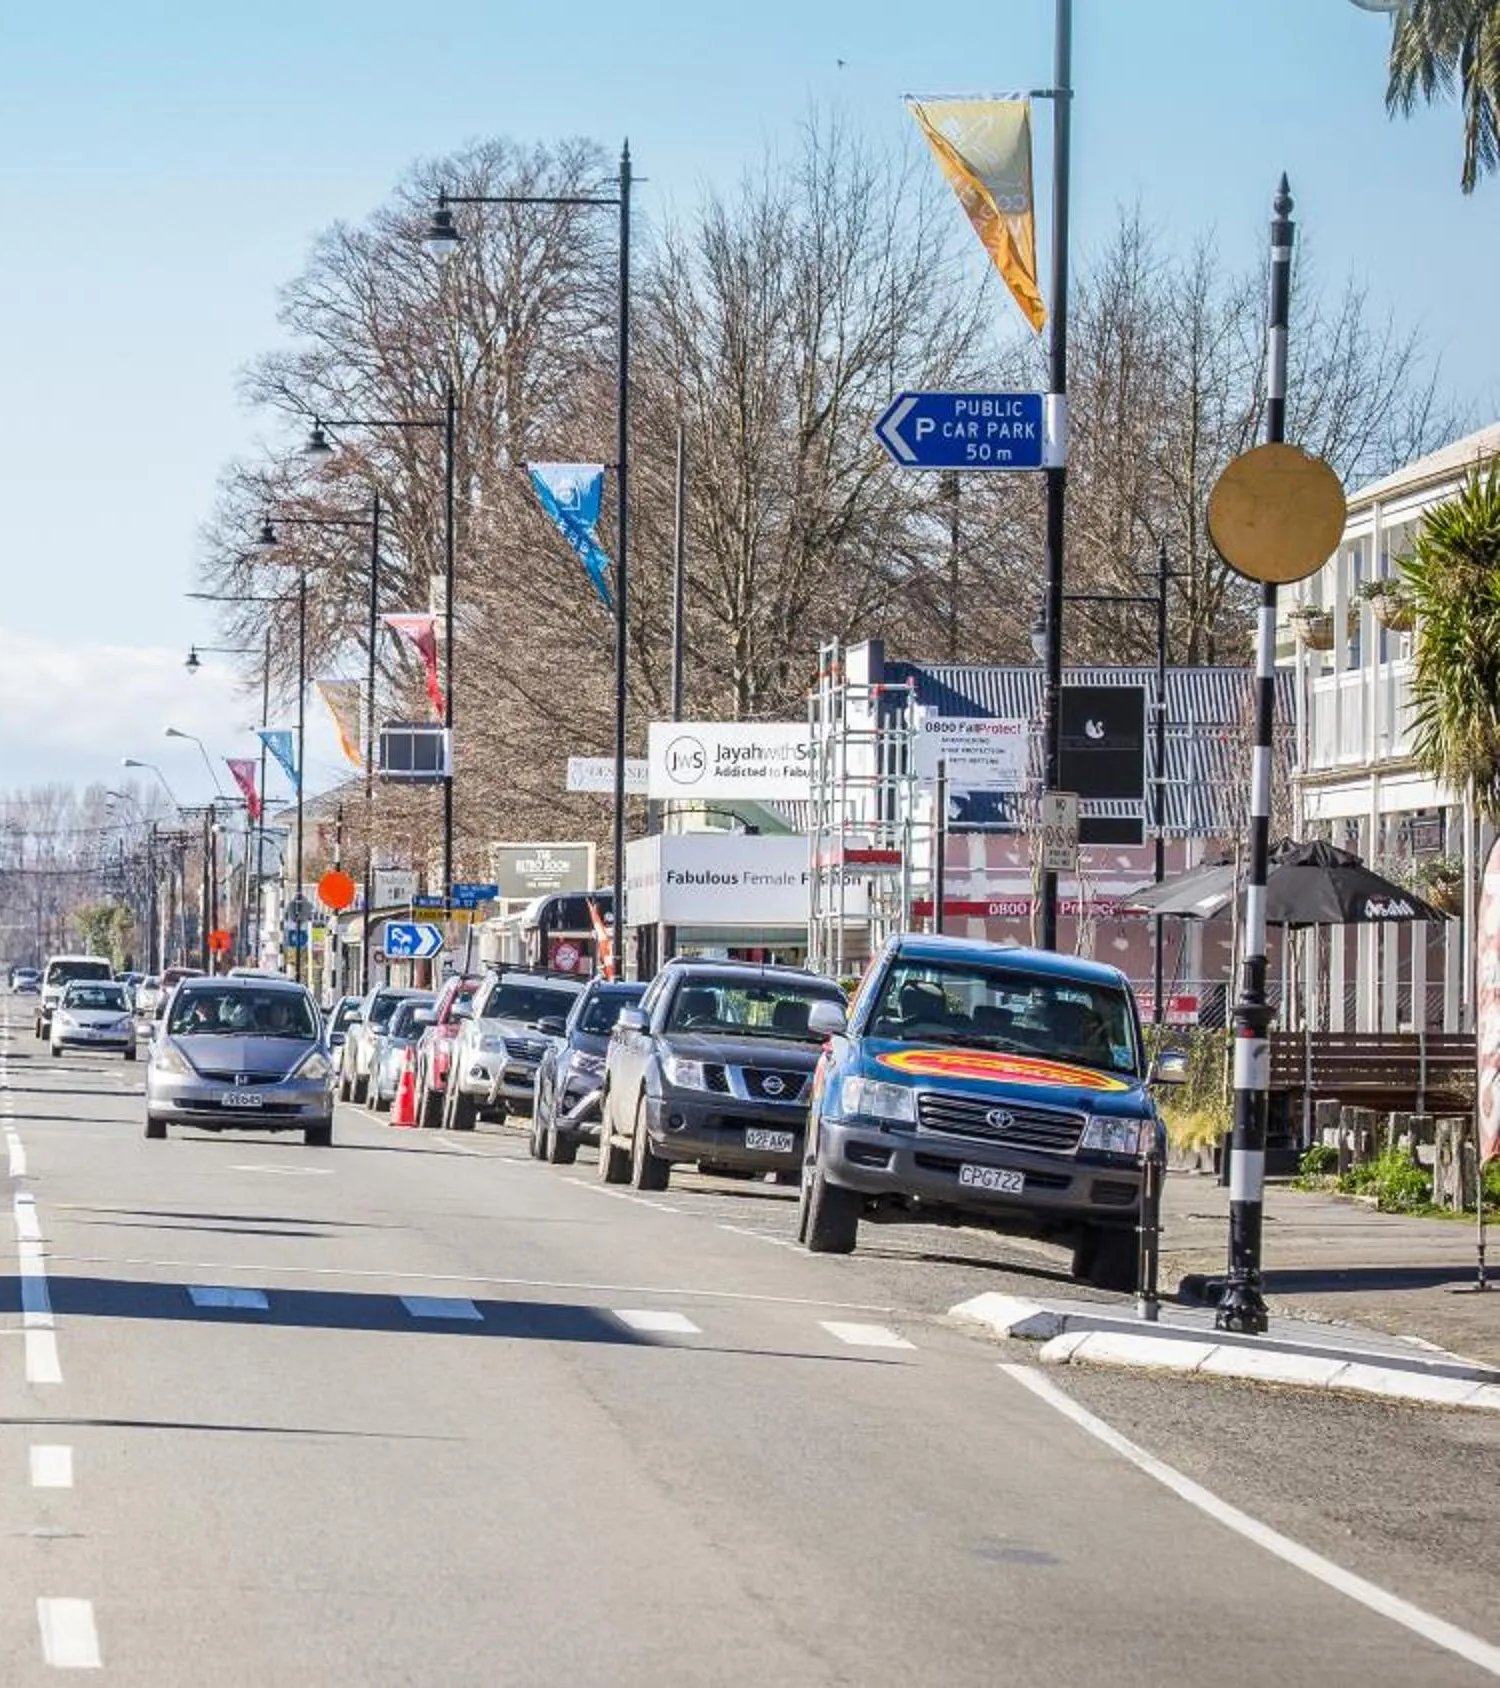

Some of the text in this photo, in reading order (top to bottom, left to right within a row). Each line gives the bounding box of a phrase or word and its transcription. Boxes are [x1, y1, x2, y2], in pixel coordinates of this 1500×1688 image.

[954, 399, 1023, 416] PUBLIC
[915, 418, 1036, 441] P CAR PARK
[966, 444, 1013, 460] 50 m
[925, 721, 957, 733] 0800
[714, 766, 766, 778] Addicted
[770, 766, 781, 777] to
[666, 869, 739, 885] Fabulous
[743, 871, 796, 885] Female
[961, 1167, 1023, 1191] CPG722
